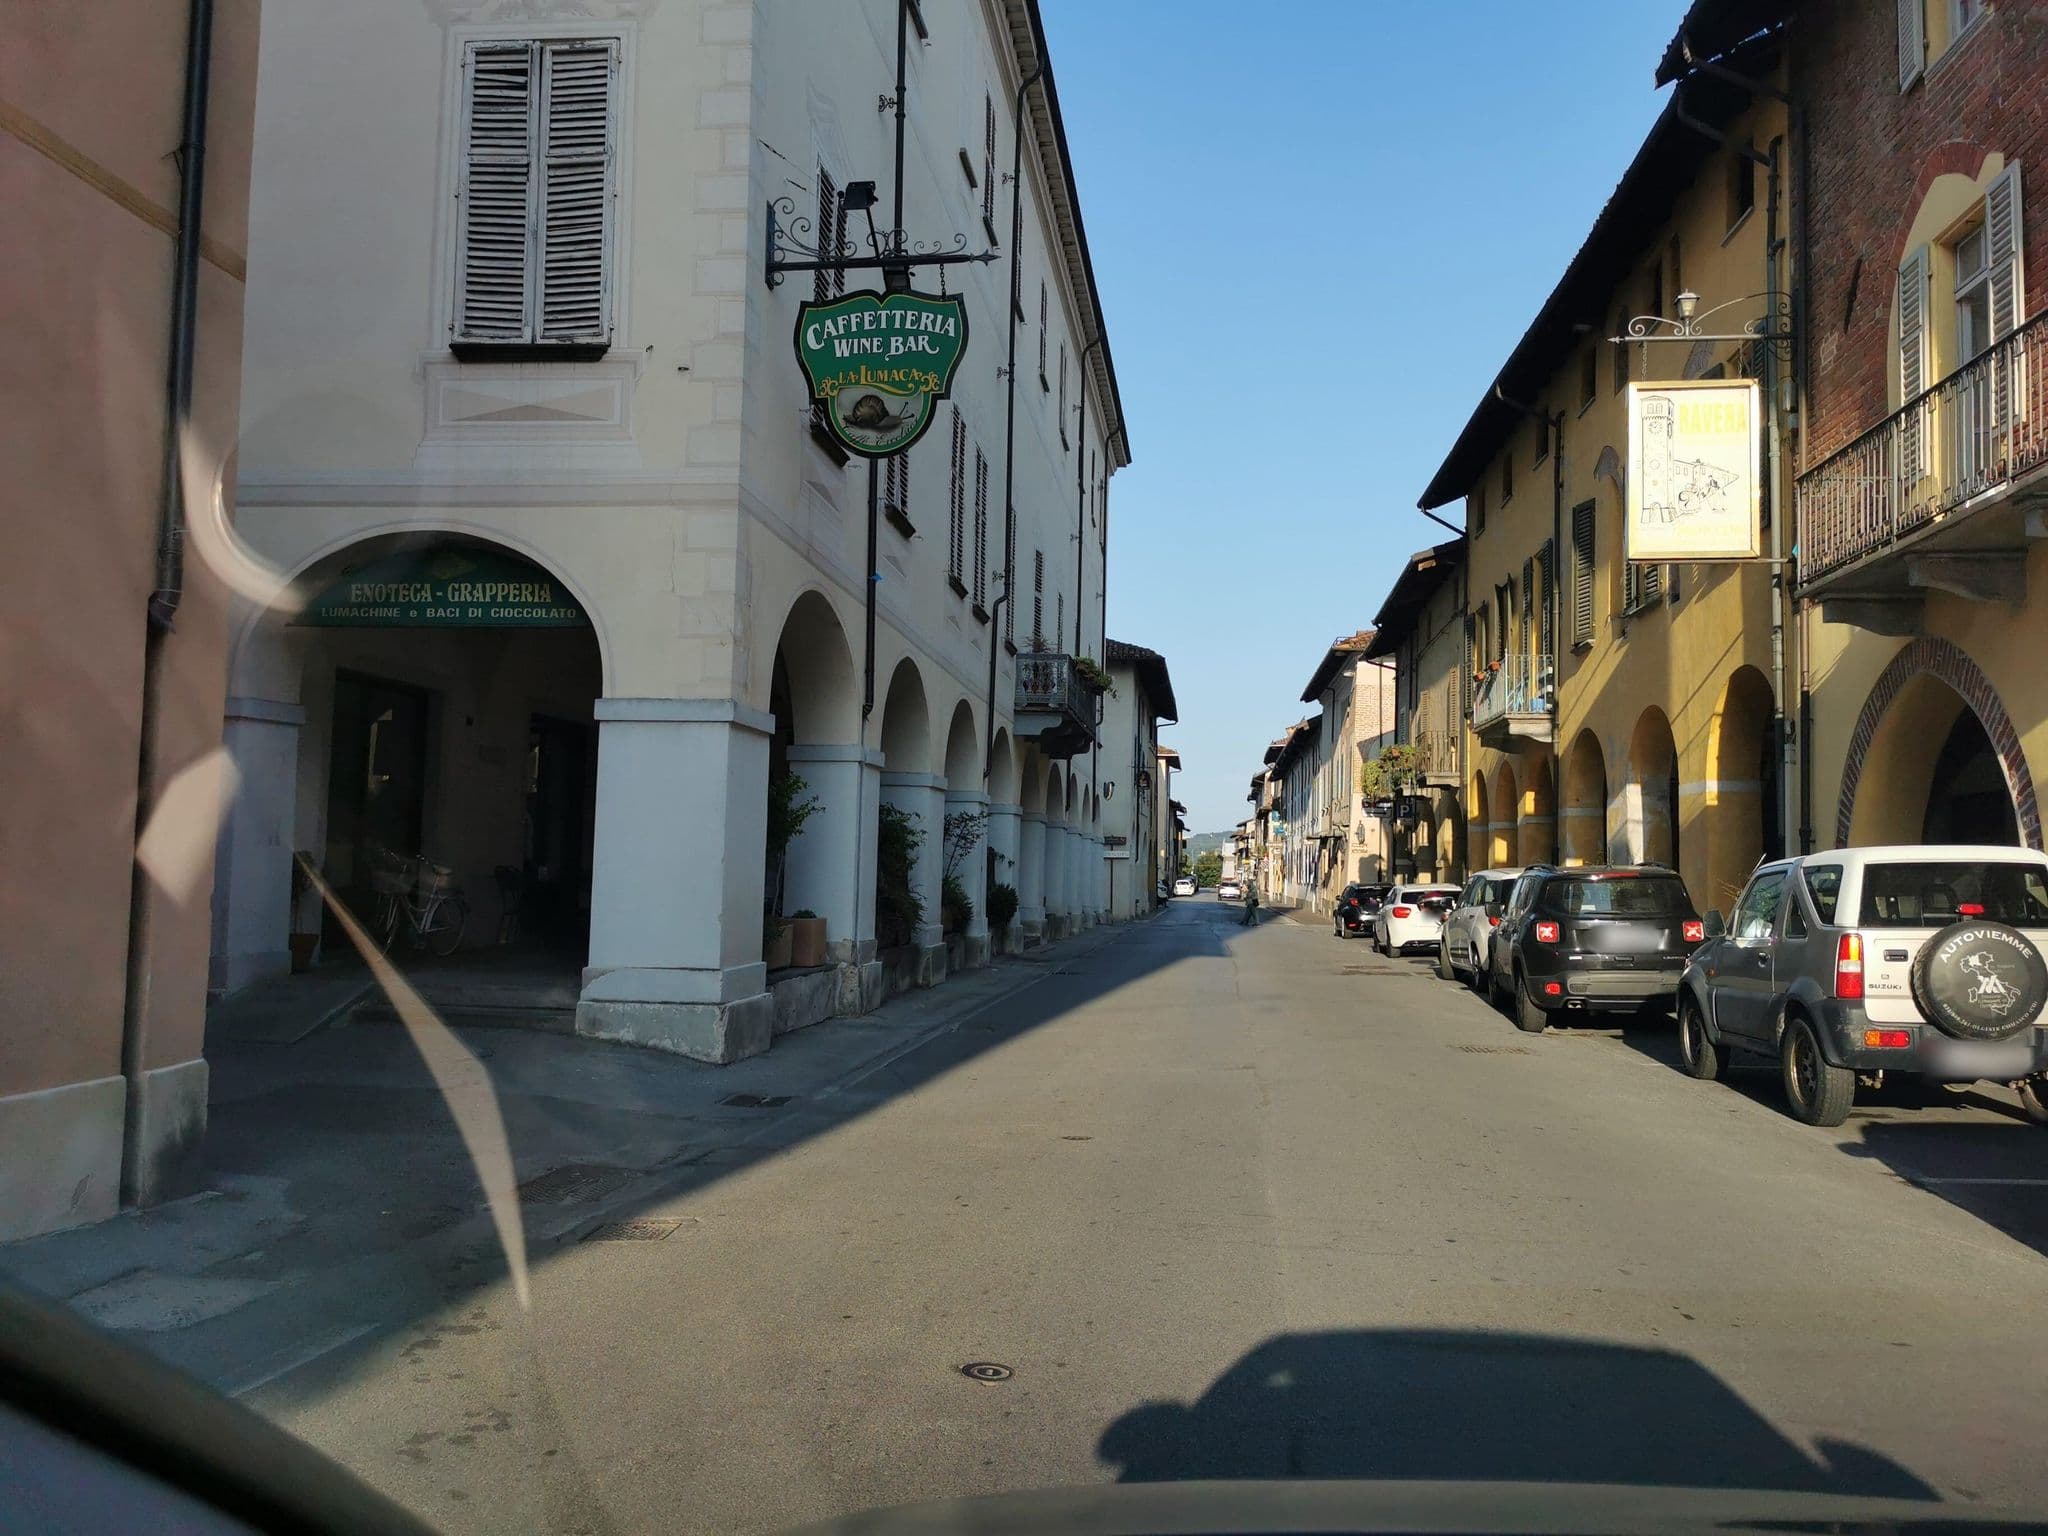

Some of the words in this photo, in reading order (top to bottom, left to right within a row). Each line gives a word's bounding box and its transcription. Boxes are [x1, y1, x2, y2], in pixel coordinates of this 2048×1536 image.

[806, 310, 957, 350] CAFFETTERIA
[834, 337, 883, 358] WINE
[885, 335, 940, 361] BAR
[839, 370, 859, 384] LA
[860, 365, 923, 387] LUMACA
[351, 583, 432, 602] ENOTECA
[448, 582, 552, 603] GRAPPERIA
[321, 607, 401, 618] LUMACHINE
[410, 609, 418, 618] e
[426, 607, 460, 618] BACI
[468, 607, 483, 618] DI
[490, 607, 577, 618] CIOCCOLATO
[1940, 930, 2033, 964] AUTOVIEMME
